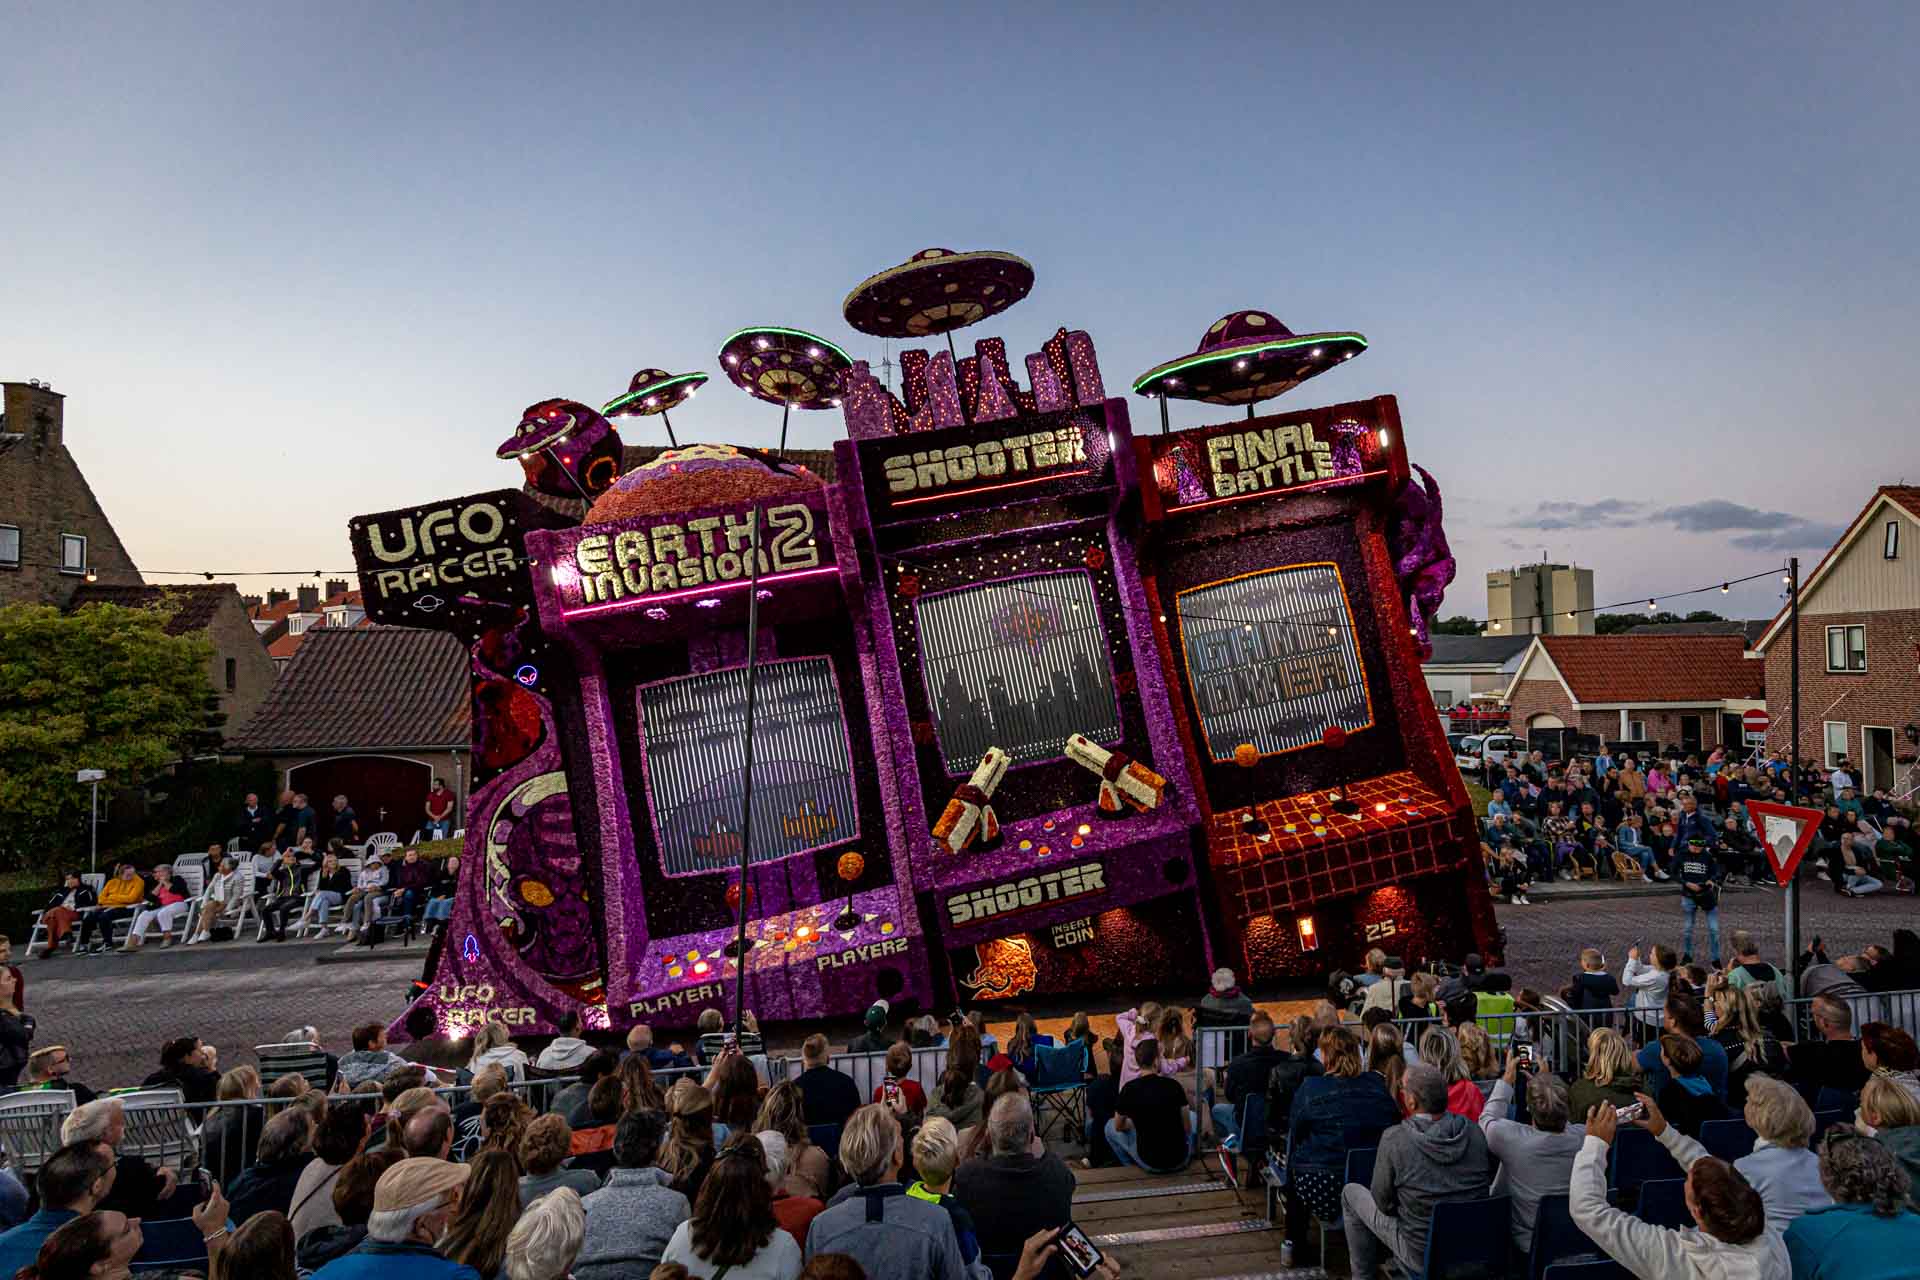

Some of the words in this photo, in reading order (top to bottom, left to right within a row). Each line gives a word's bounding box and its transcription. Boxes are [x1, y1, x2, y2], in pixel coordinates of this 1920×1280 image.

[883, 426, 1087, 492] SHOOTER
[1207, 422, 1329, 473] FINAL
[1213, 452, 1335, 497] BATTLE
[367, 503, 504, 563] UFO
[577, 510, 762, 573] EARTH
[767, 503, 819, 572] 2
[377, 547, 517, 598] RACER
[1192, 608, 1341, 673] GAME
[1201, 652, 1348, 715] OVER
[947, 863, 1107, 924] SHOOTER
[1051, 916, 1092, 935] INSERT
[1054, 927, 1095, 949] COIN
[1365, 919, 1396, 942] 25
[440, 984, 496, 1003] UFO
[447, 1007, 537, 1025] RACER
